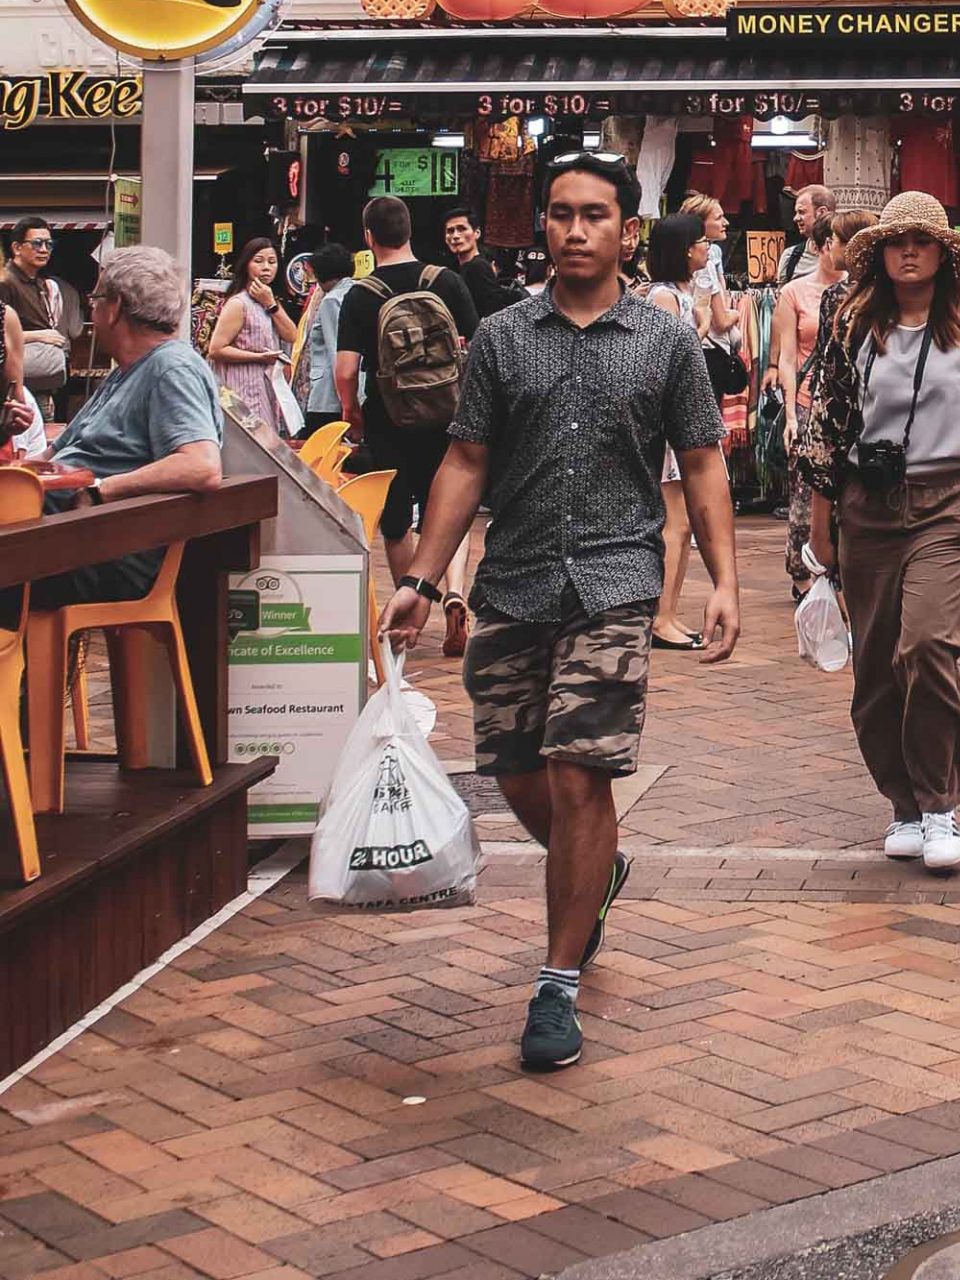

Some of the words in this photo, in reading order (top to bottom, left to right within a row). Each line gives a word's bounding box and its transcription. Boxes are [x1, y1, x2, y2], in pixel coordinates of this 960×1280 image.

[737, 13, 831, 34] MONEY
[49, 70, 142, 118] Kee
[709, 93, 745, 113] for
[899, 92, 914, 111] 3
[478, 95, 493, 115] 3
[262, 610, 297, 620] Winner
[261, 645, 272, 656] of
[275, 644, 335, 656] Excellence
[245, 704, 287, 715] Seafood
[289, 704, 344, 714] Restaurant
[371, 843, 429, 867] HOUR
[399, 885, 458, 905] CENTRE
